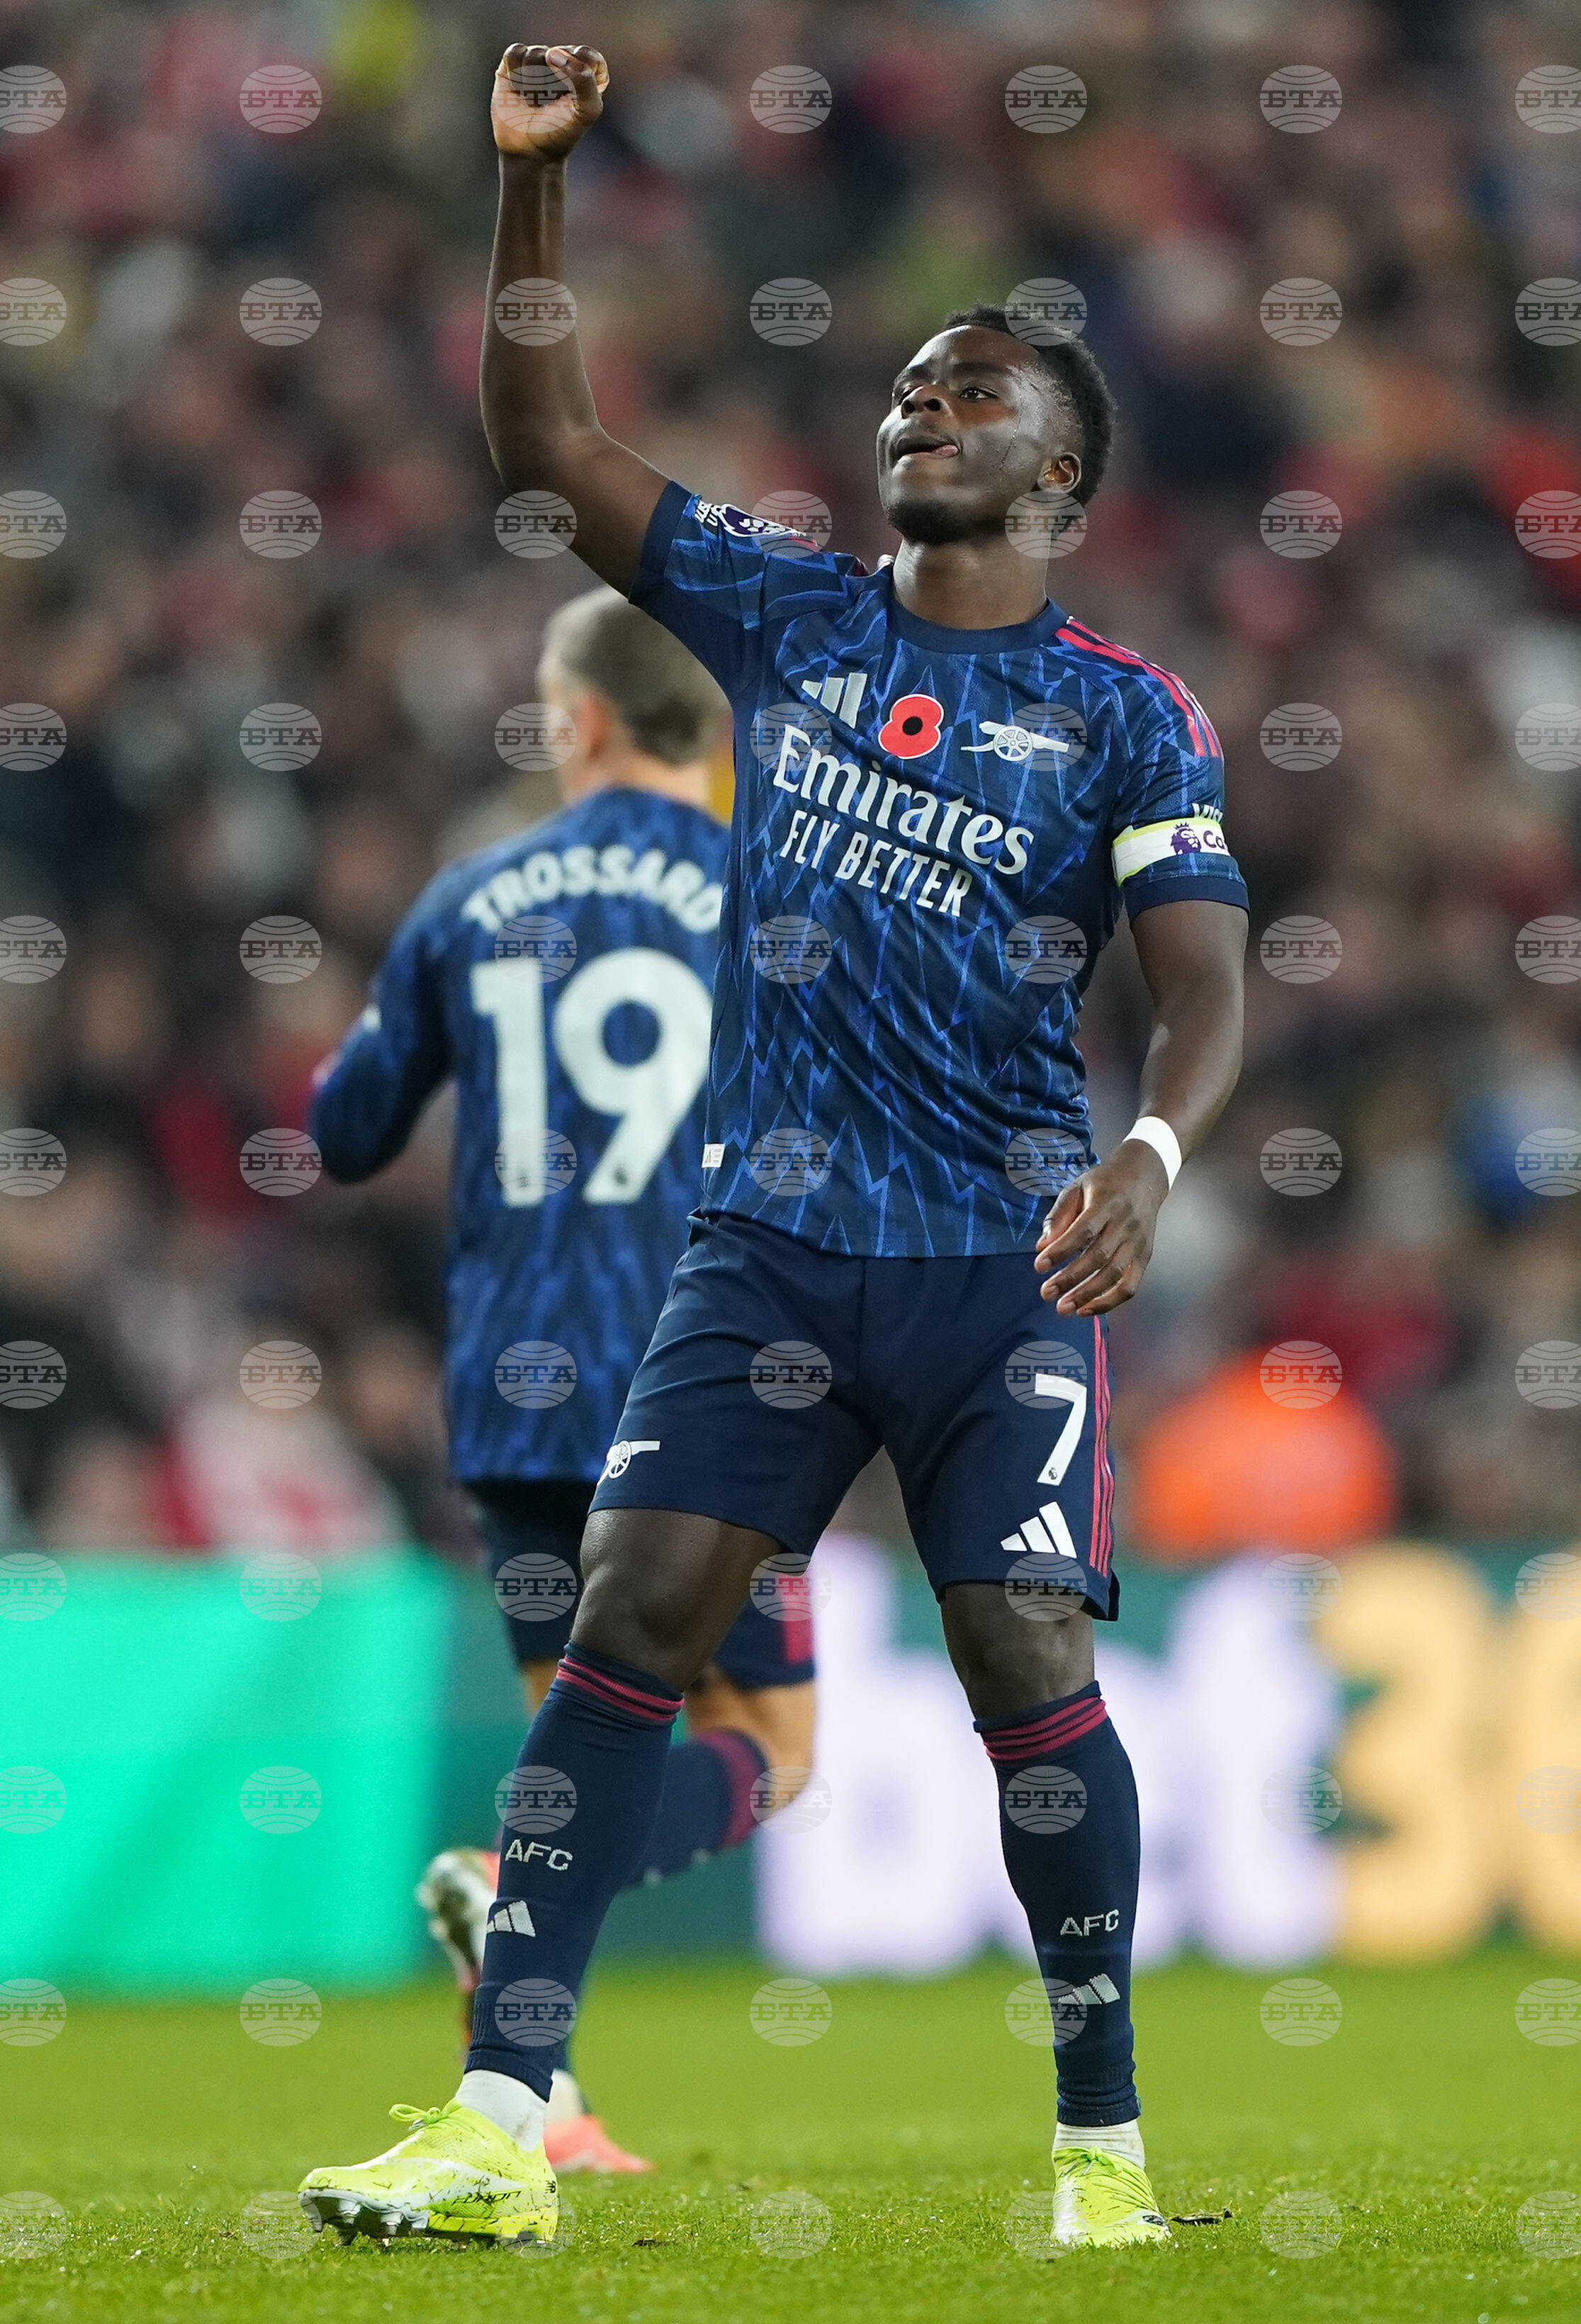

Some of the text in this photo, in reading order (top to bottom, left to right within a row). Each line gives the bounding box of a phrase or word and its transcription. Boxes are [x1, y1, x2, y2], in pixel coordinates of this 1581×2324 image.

[773, 723, 1034, 876] Emirates
[780, 809, 973, 918] FLY BETTER
[469, 945, 712, 1207] 19
[1035, 1373, 1087, 1486] 7
[505, 1839, 573, 1871] AFC
[1059, 1909, 1119, 1936] AFC
